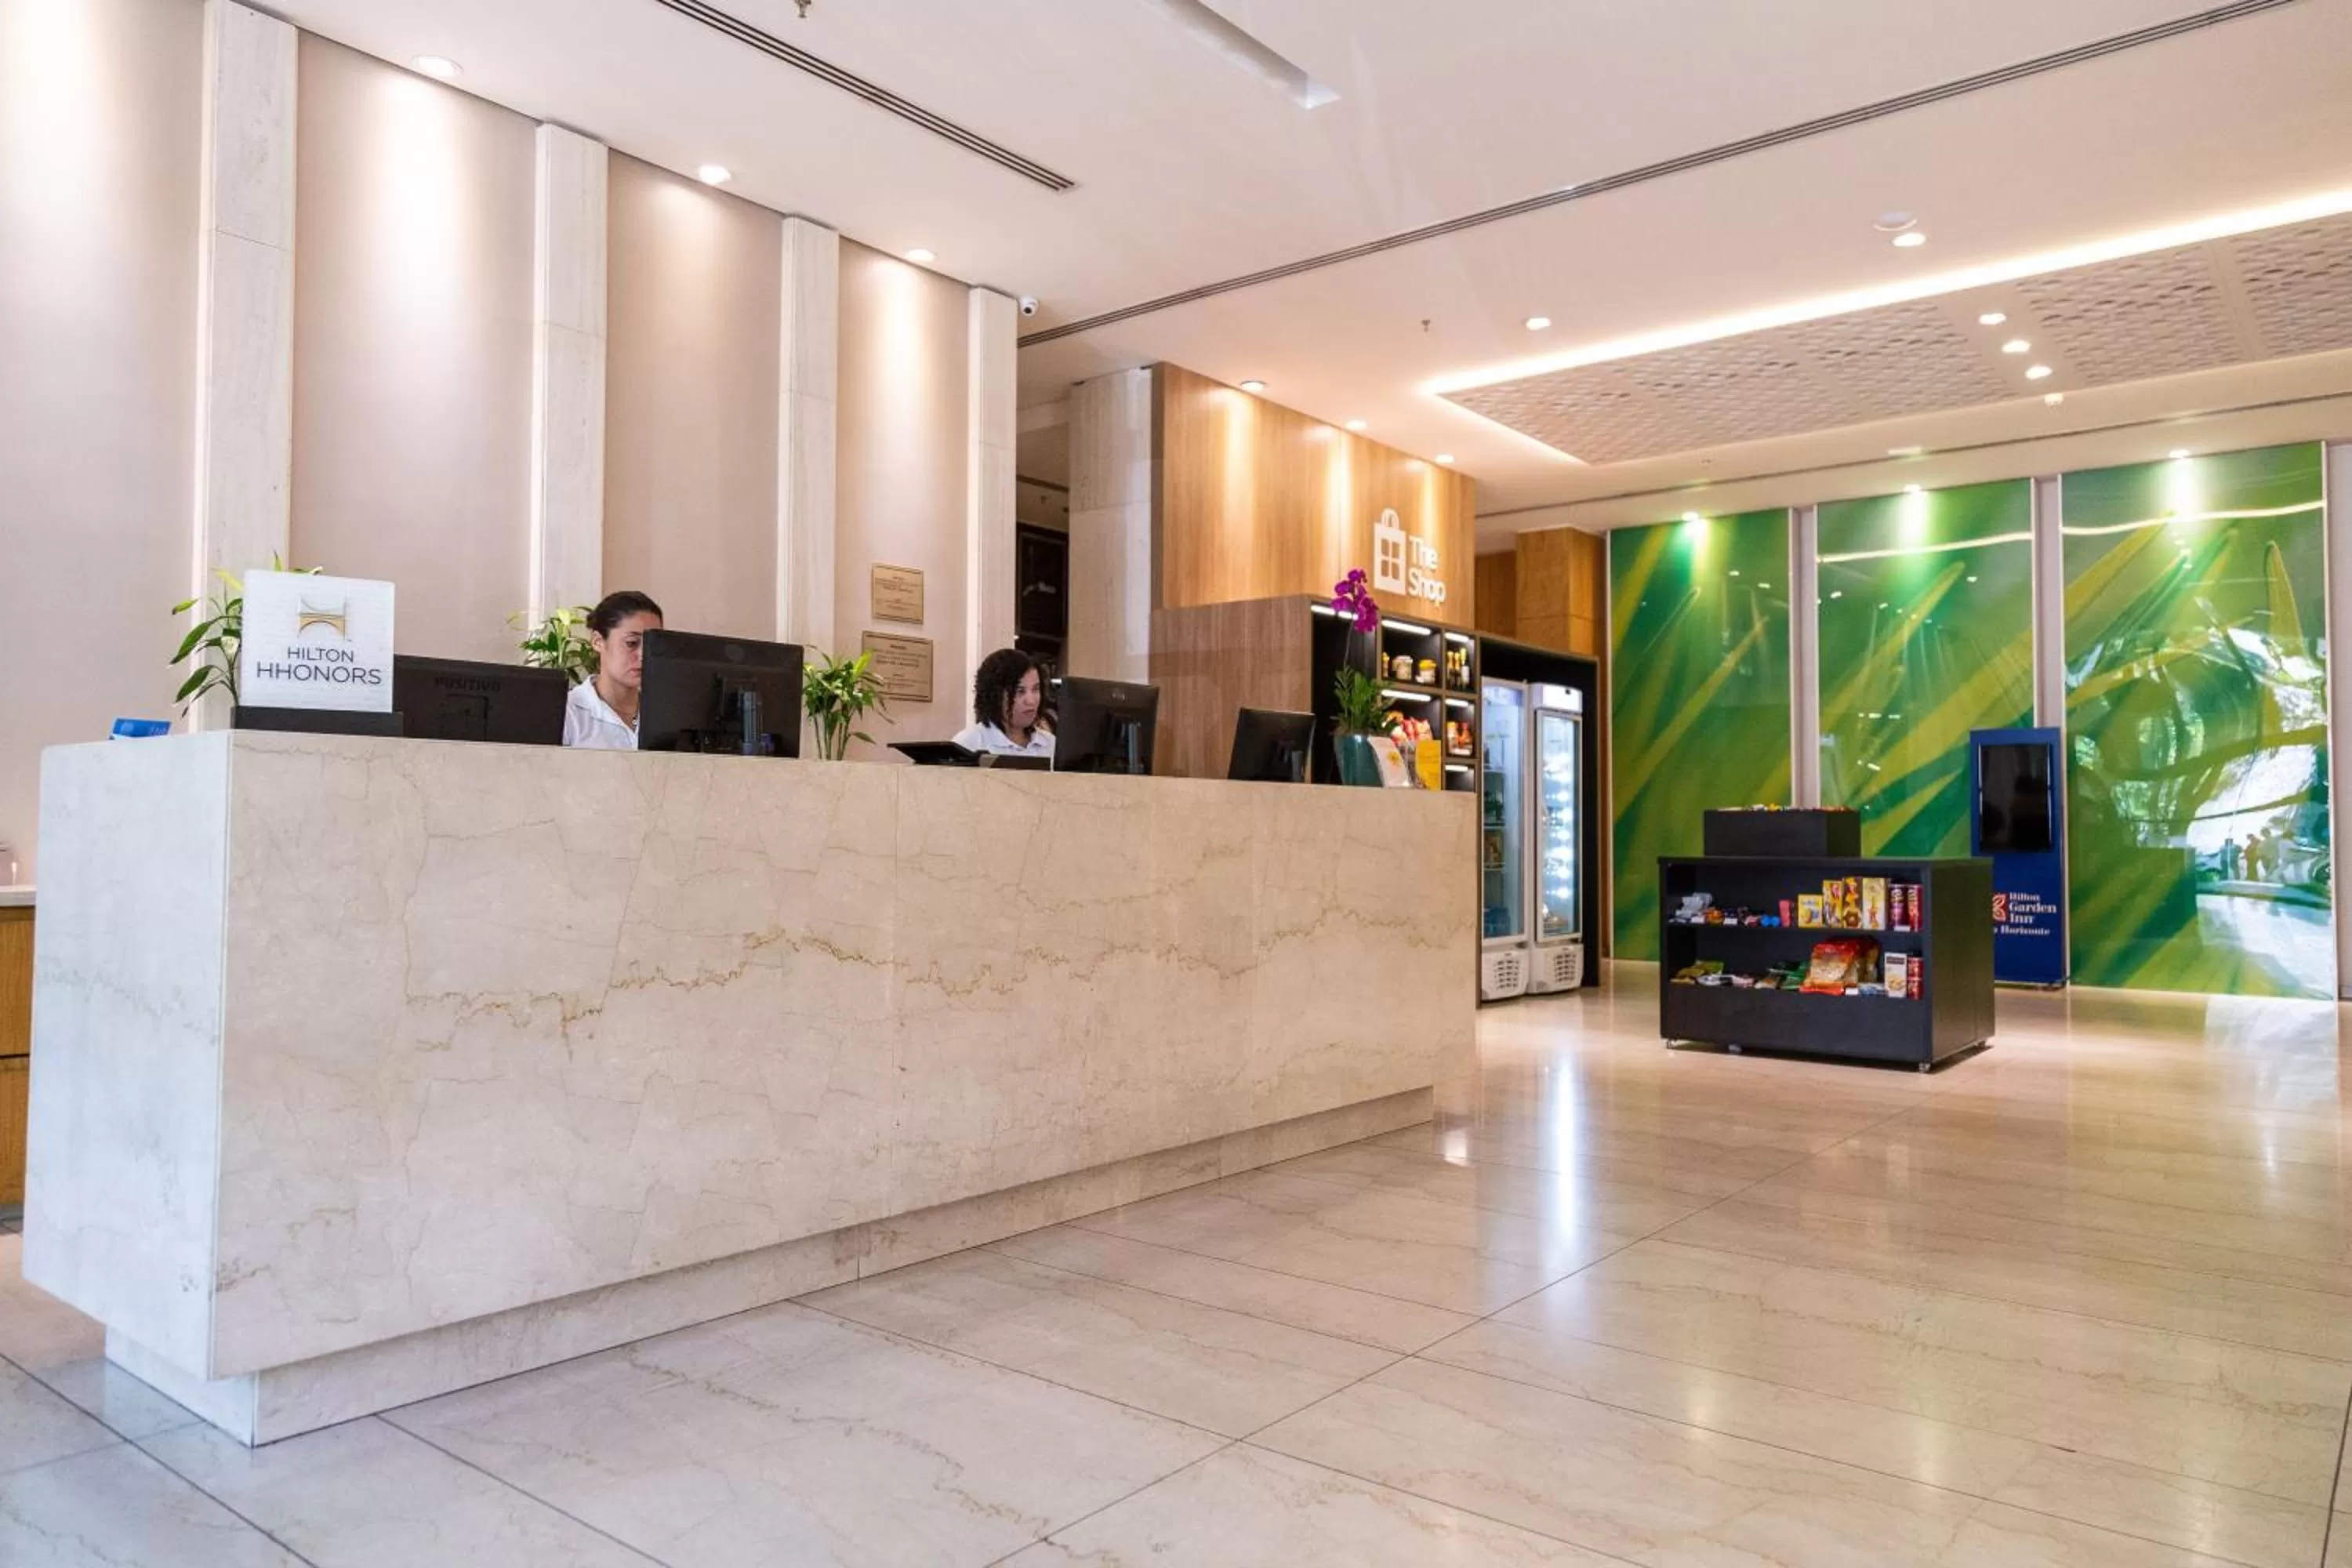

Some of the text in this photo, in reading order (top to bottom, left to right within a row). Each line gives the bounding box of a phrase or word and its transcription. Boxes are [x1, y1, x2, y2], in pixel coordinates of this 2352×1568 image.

[1409, 535, 1438, 570] The
[1408, 568, 1446, 607] Shop
[287, 646, 354, 663] HILTON
[256, 661, 382, 685] HHONORS
[2009, 891, 2040, 902] Hilton
[2009, 902, 2056, 914] Garden
[2010, 913, 2034, 924] Inn
